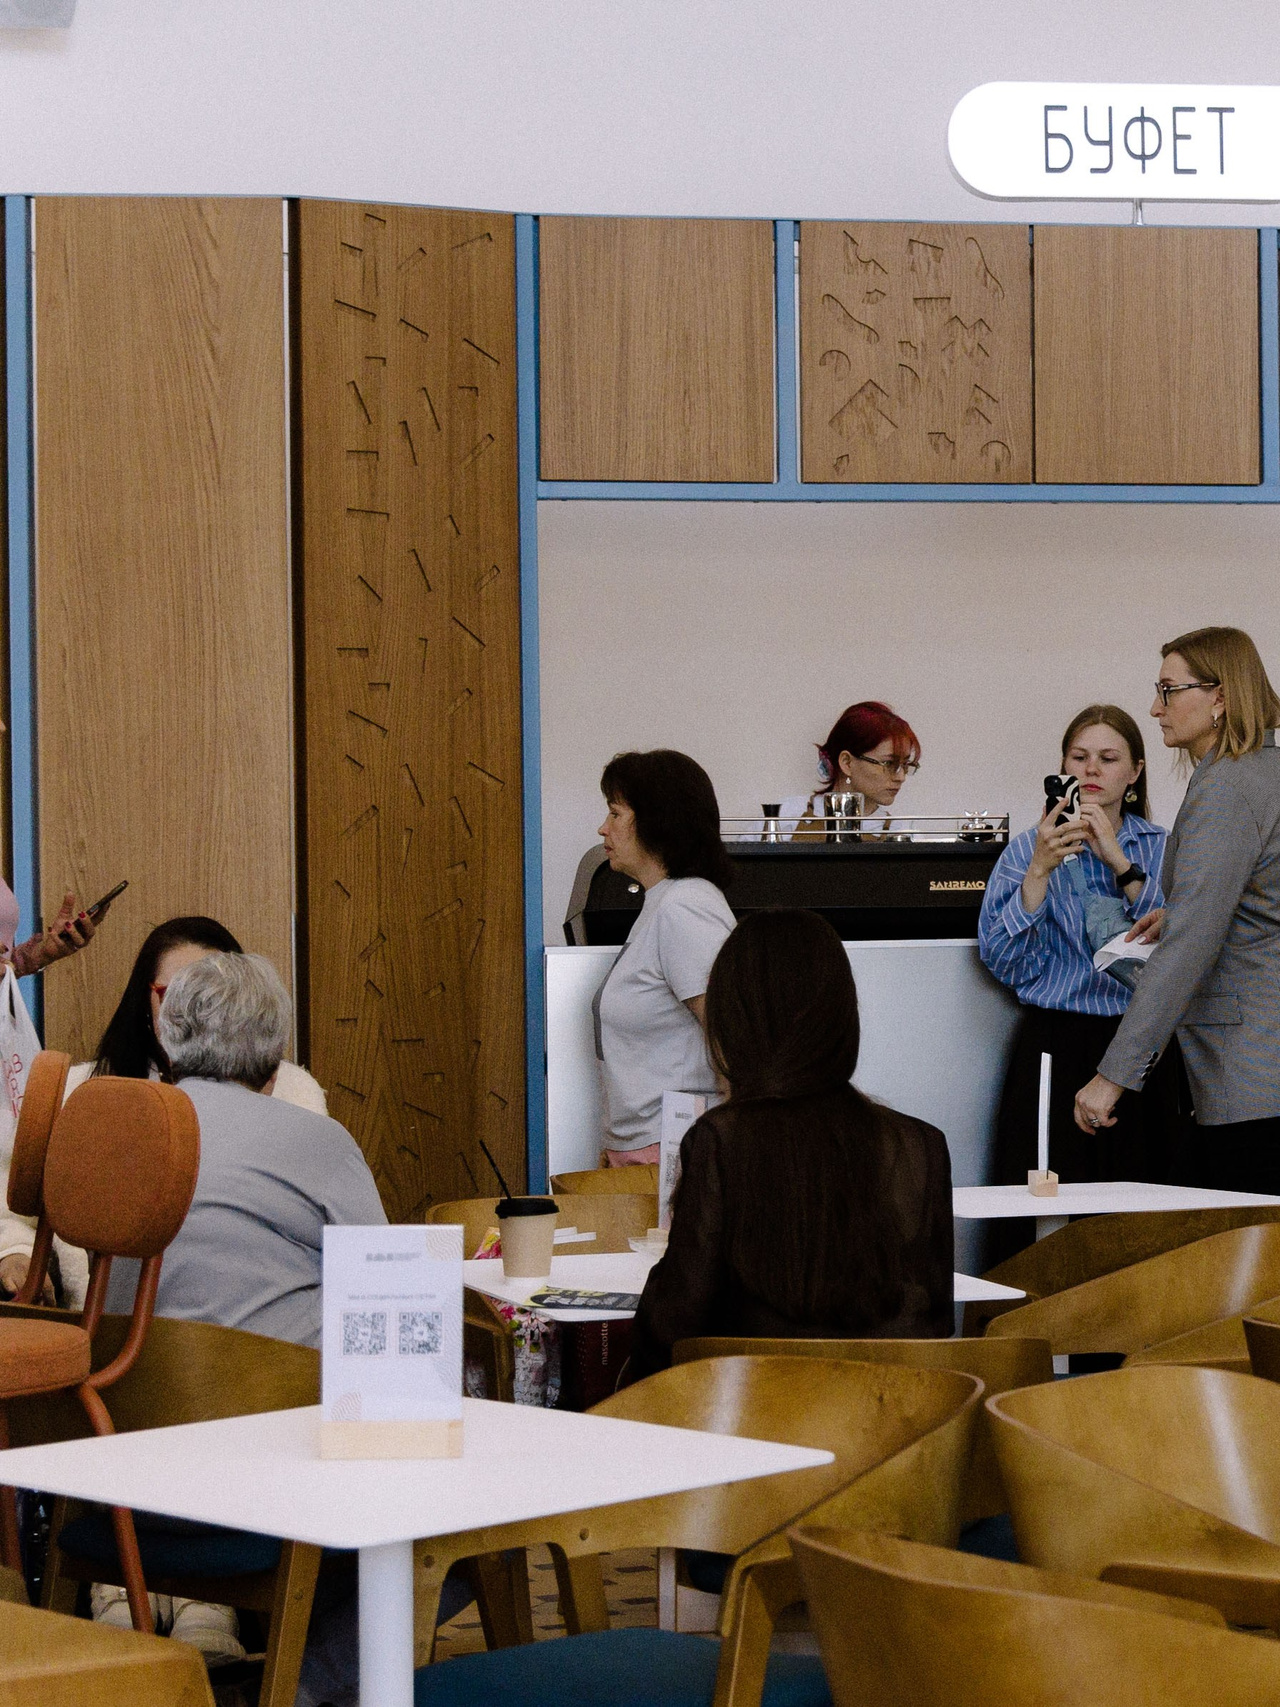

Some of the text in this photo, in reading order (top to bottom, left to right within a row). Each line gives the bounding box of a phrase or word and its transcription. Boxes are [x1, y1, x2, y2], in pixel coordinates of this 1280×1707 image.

[1044, 104, 1235, 175] БУФЕТ
[929, 881, 986, 889] SANREMO
[600, 1321, 609, 1366] mascotte
